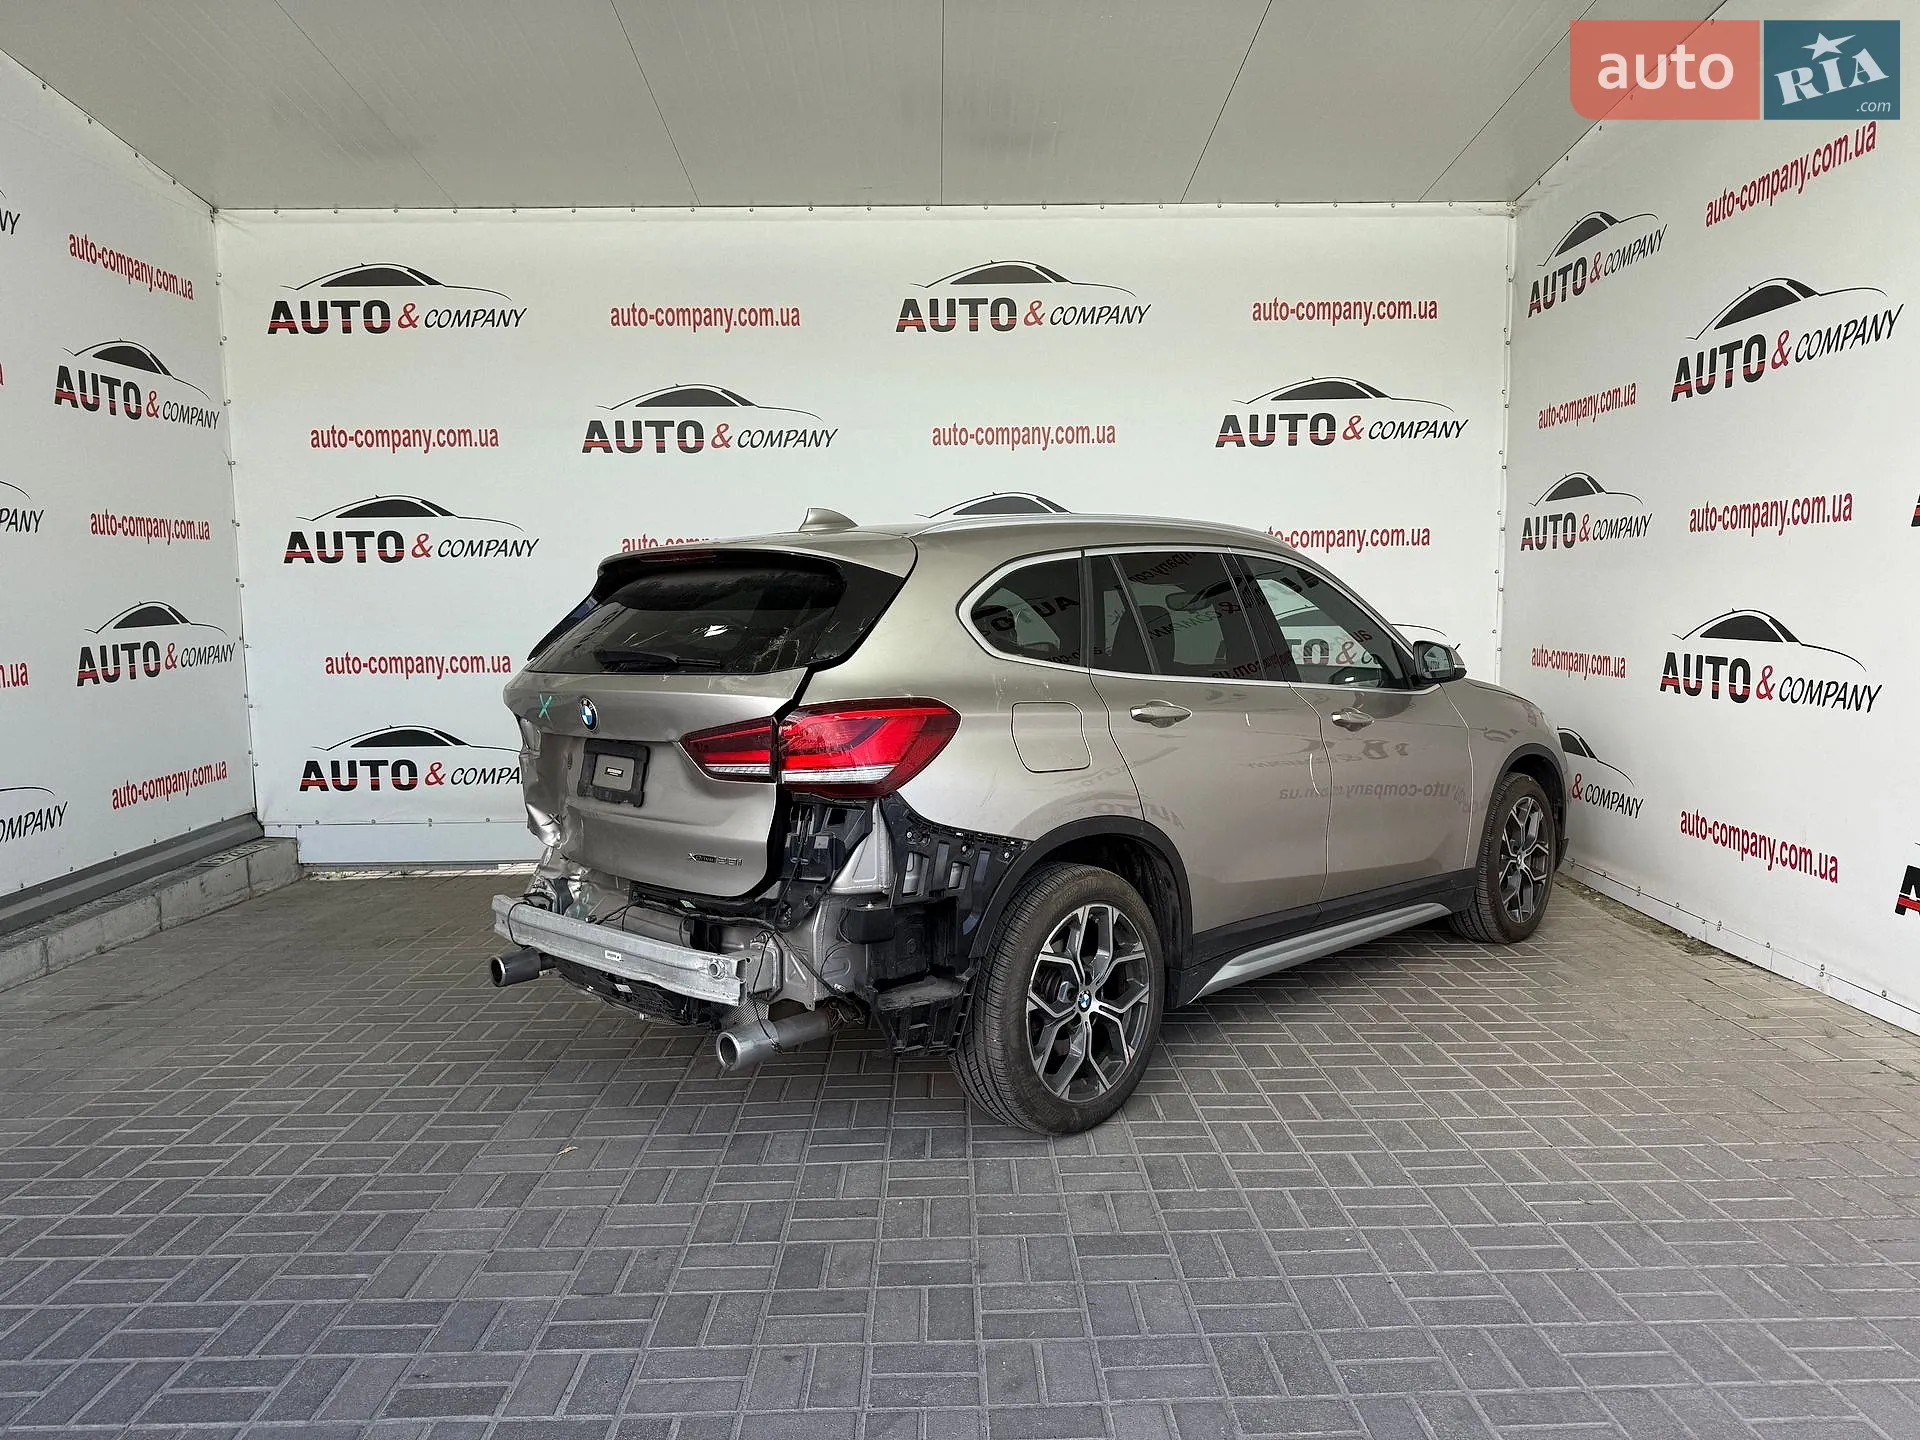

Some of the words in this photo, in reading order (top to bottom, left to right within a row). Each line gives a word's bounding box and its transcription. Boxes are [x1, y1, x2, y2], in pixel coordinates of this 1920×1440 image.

[1706, 121, 1876, 227] auto-company.com.ua
[69, 234, 193, 300] auto-company.com.ua
[1528, 256, 1587, 318] AUTO
[1590, 252, 1602, 283] &
[1604, 224, 1667, 276] COMPANY
[268, 300, 390, 334] AUTO
[398, 303, 419, 328] &
[425, 308, 527, 328] COMPANY
[611, 303, 800, 333] auto-company.com.ua
[896, 298, 1017, 332] AUTO
[1024, 300, 1045, 326] &
[1050, 304, 1151, 325] COMPANY
[1253, 297, 1437, 326] auto-company.com.ua
[1671, 334, 1766, 402] AUTO
[1771, 330, 1792, 369] &
[1795, 304, 1904, 363] COMPANY
[55, 365, 141, 420] AUTO
[146, 391, 159, 418] &
[163, 401, 219, 429] COMPANY
[1539, 383, 1636, 429] auto-company.com.ua
[311, 425, 499, 454] auto-company.com.ua
[582, 420, 704, 453] AUTO
[711, 423, 733, 448] &
[737, 428, 838, 448] COMPANY
[933, 422, 1115, 451] auto-company.com.ua
[1215, 413, 1336, 447] AUTO
[1343, 415, 1364, 440] &
[1369, 419, 1469, 440] COMPANY
[91, 509, 210, 545] auto-company.com.ua
[1521, 512, 1576, 551] AUTO
[1579, 514, 1591, 542] &
[1593, 513, 1652, 541] COMPANY
[1690, 493, 1852, 537] auto-company.com.ua
[284, 531, 404, 563] AUTO
[412, 533, 433, 558] &
[438, 538, 539, 558] COMPANY
[77, 641, 160, 686] AUTO
[165, 643, 178, 670] &
[181, 642, 235, 667] COMPANY
[326, 652, 511, 680] auto-company.com.ua
[1532, 644, 1625, 680] auto-company.com.ua
[1660, 652, 1751, 703] AUTO
[1756, 665, 1775, 700] &
[1779, 676, 1882, 713] COMPANY
[112, 761, 227, 810] auto-company.com.ua
[299, 759, 418, 791] AUTO
[425, 762, 444, 785] &
[1572, 774, 1583, 800] &
[1585, 783, 1643, 819] COMPANY
[1681, 809, 1838, 883] auto-company.com.ua
